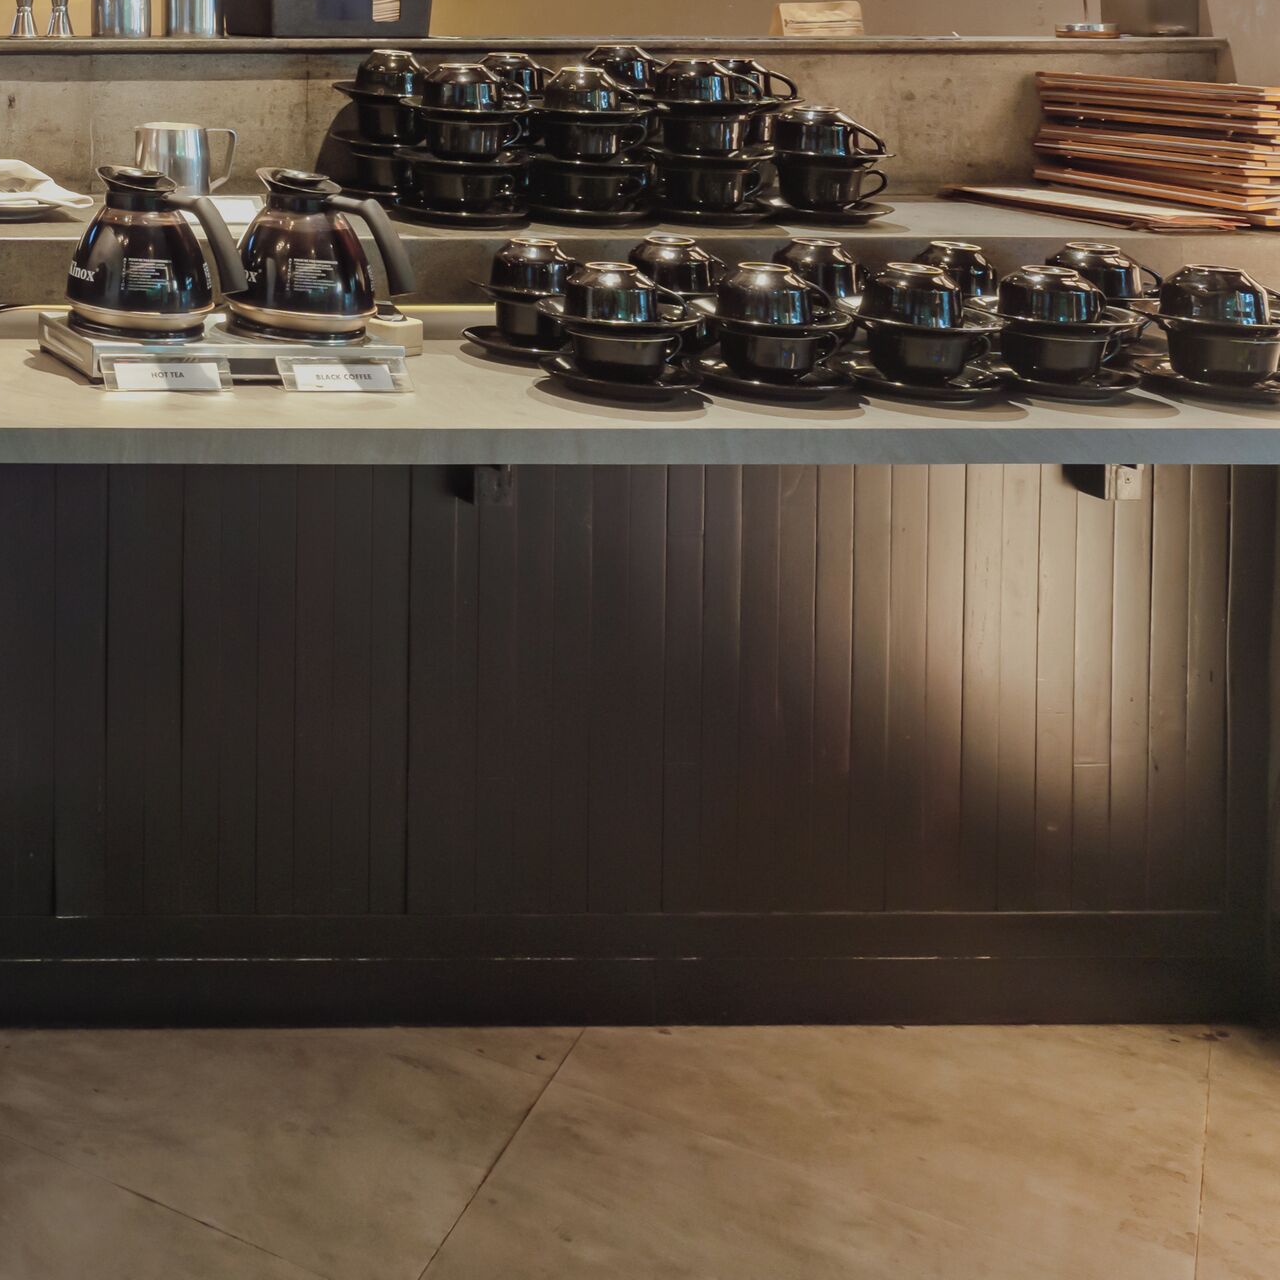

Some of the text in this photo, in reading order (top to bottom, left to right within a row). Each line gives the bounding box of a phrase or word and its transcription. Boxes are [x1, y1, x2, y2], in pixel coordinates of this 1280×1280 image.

[151, 371, 185, 379] HOT TEA
[315, 373, 373, 381] BLACK COFFEE
